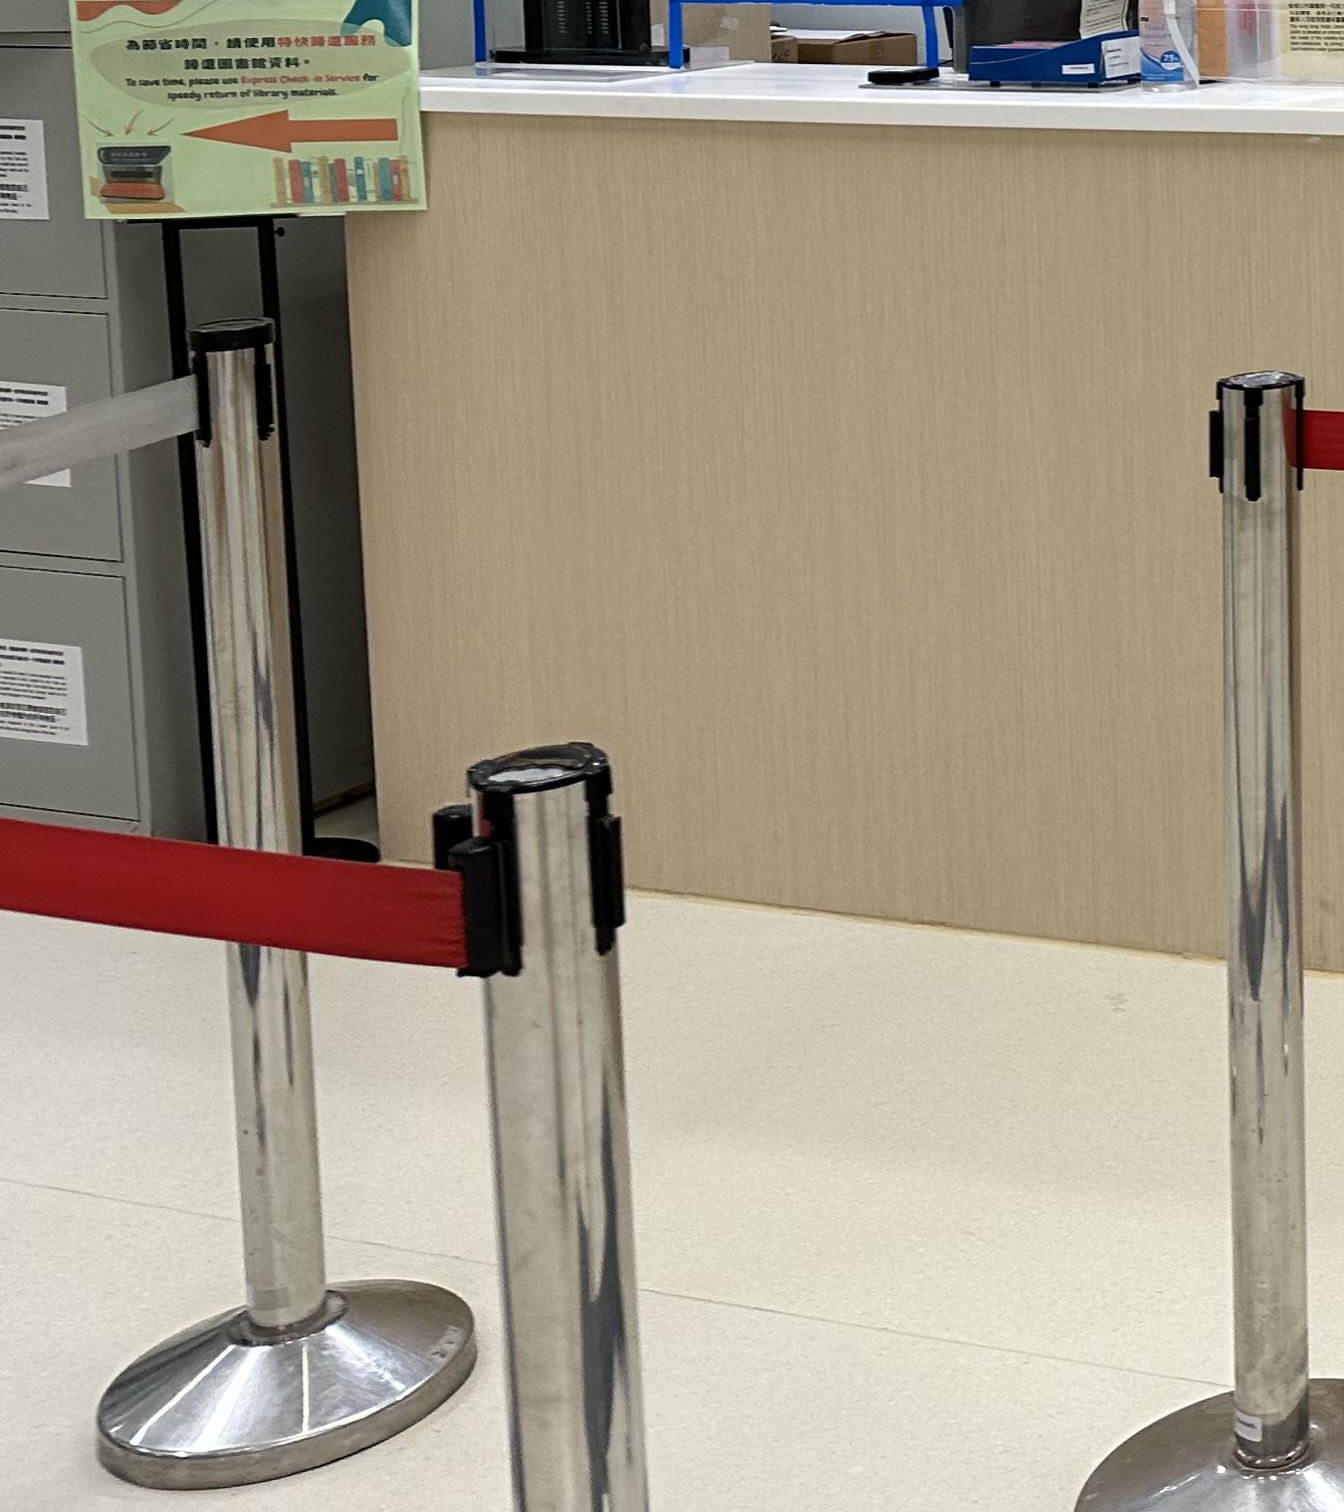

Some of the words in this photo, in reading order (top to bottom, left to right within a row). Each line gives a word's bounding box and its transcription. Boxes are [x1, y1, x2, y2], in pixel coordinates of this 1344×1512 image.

[189, 77, 219, 88] please
[241, 76, 278, 85] Express
[325, 74, 360, 83] Service
[363, 73, 379, 82] for
[167, 91, 201, 101] speedy
[204, 91, 238, 99] return
[253, 89, 288, 99] library
